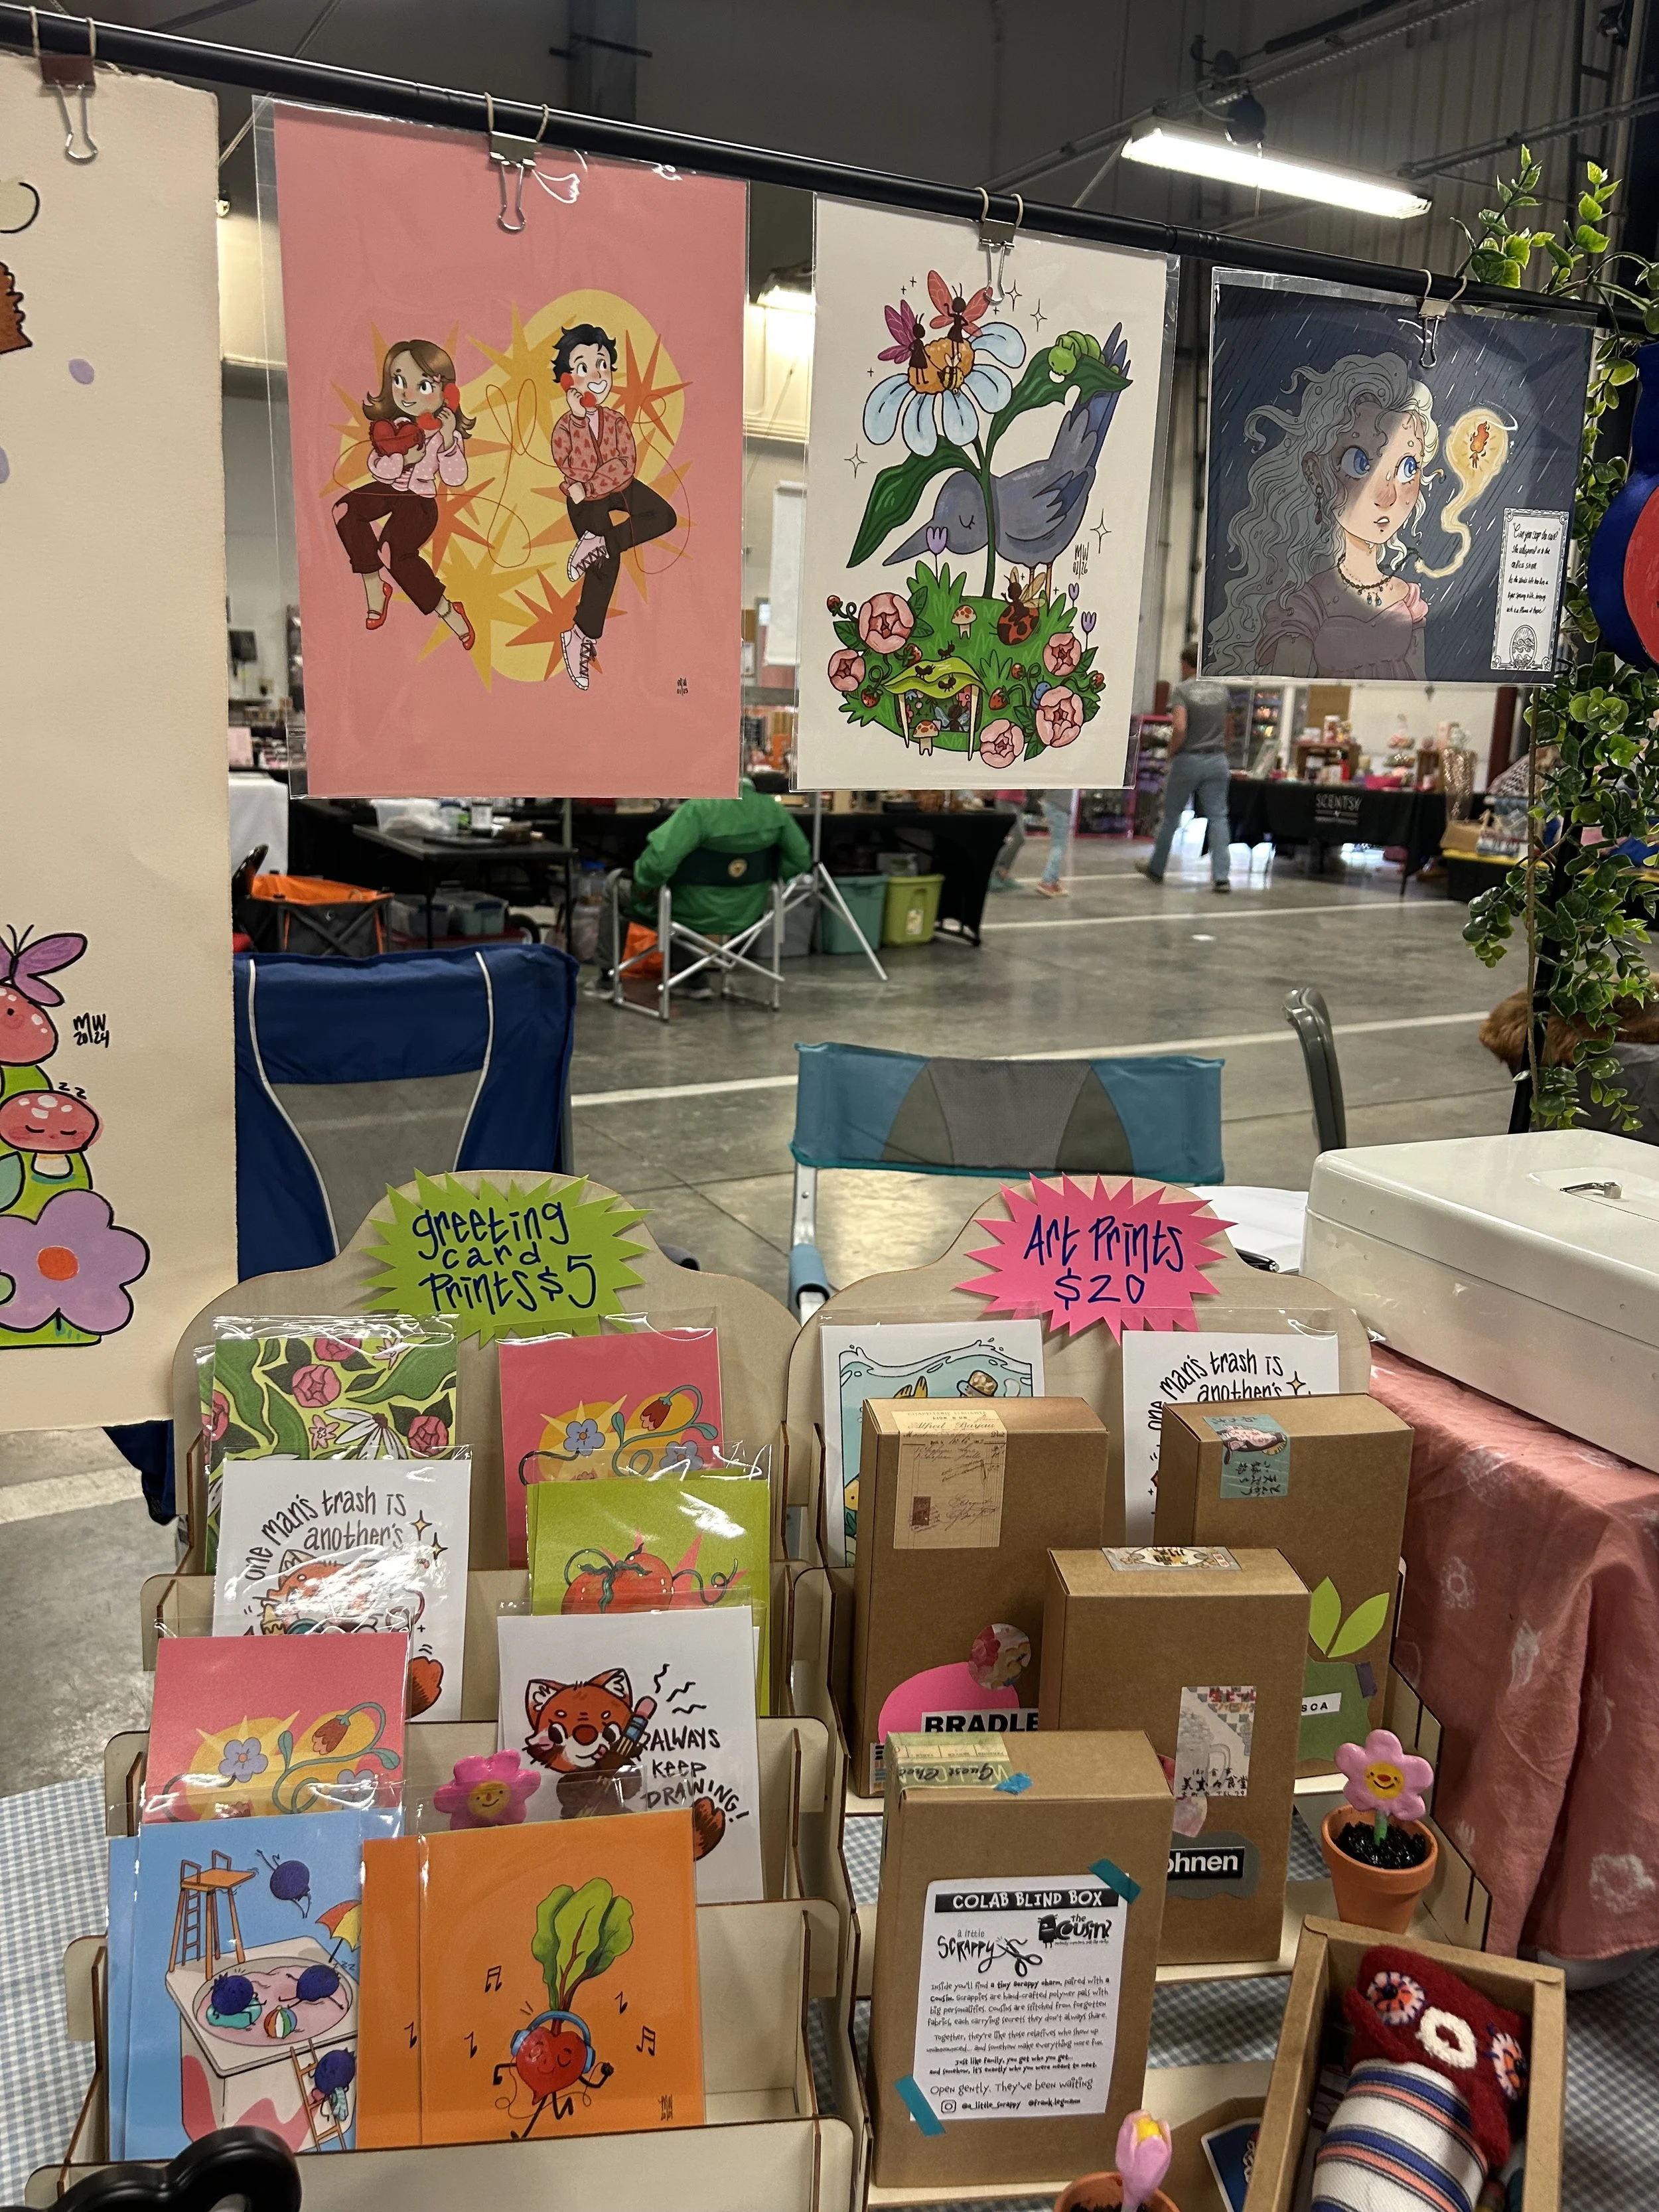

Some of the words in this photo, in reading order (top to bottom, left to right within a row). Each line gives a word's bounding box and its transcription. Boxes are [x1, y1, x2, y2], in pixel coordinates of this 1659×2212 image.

[1316, 793, 1362, 811] SCENTSY
[73, 1013, 106, 1034] MW
[413, 1201, 570, 1260] greeting
[1023, 1214, 1081, 1267] Art
[1088, 1215, 1185, 1273] Prints
[443, 1241, 541, 1269] card
[1054, 1267, 1145, 1311] $20
[1210, 1348, 1257, 1375] trash
[246, 1546, 273, 1581] one
[261, 1494, 319, 1546] man's
[321, 1485, 376, 1516] trash
[303, 1519, 403, 1551] another's
[925, 1712, 1039, 1732] BRADLE
[650, 1725, 721, 1751] ALWAYS
[949, 1763, 993, 1781] Guest
[641, 1777, 750, 1823] DRAWING!
[953, 1893, 1009, 1909] COLAB
[1015, 1891, 1062, 1907] BLIND
[1069, 1889, 1102, 1907] BOX
[964, 1927, 985, 1938] little
[954, 1981, 973, 1992] you'll
[975, 1981, 988, 1990] find
[997, 1980, 1011, 1990] tiny
[1064, 1976, 1086, 1987] paired
[1088, 1975, 1103, 1984] with
[1003, 1990, 1047, 2000] hand-crafted
[1049, 1990, 1075, 2000] polymer
[1077, 1988, 1090, 1998] pals
[1093, 1987, 1108, 1996] with
[930, 2006, 941, 2016] big
[943, 2004, 986, 2015] personalities.
[1027, 2002, 1053, 2011] stitched
[1073, 2000, 1106, 2010] forgotten
[971, 2016, 1000, 2027] carrying
[1001, 2015, 1025, 2024] secrets
[1028, 2014, 1043, 2024] they
[1045, 2014, 1062, 2022] don't
[1064, 2012, 1086, 2023] always
[968, 2031, 991, 2042] they're
[993, 2030, 1006, 2040] like
[1008, 2030, 1025, 2039] those
[1027, 2028, 1056, 2037] relatives
[1058, 2028, 1071, 2036] who
[1073, 2028, 1089, 2036] show
[974, 2043, 986, 2051] and
[988, 2042, 1016, 2051] somehow
[1018, 2041, 1034, 2051] make
[1036, 2039, 1072, 2051] everything
[942, 2067, 970, 2075] somehow,
[984, 2065, 1007, 2075] exactly
[970, 2057, 981, 2065] like
[983, 2056, 1005, 2065] family,
[1019, 2055, 1029, 2064] get
[930, 2085, 955, 2097] Open
[958, 2081, 991, 2097] gently.
[995, 2081, 1032, 2095] They've
[1035, 2079, 1056, 2091] been
[1059, 2076, 1093, 2090] waiting
